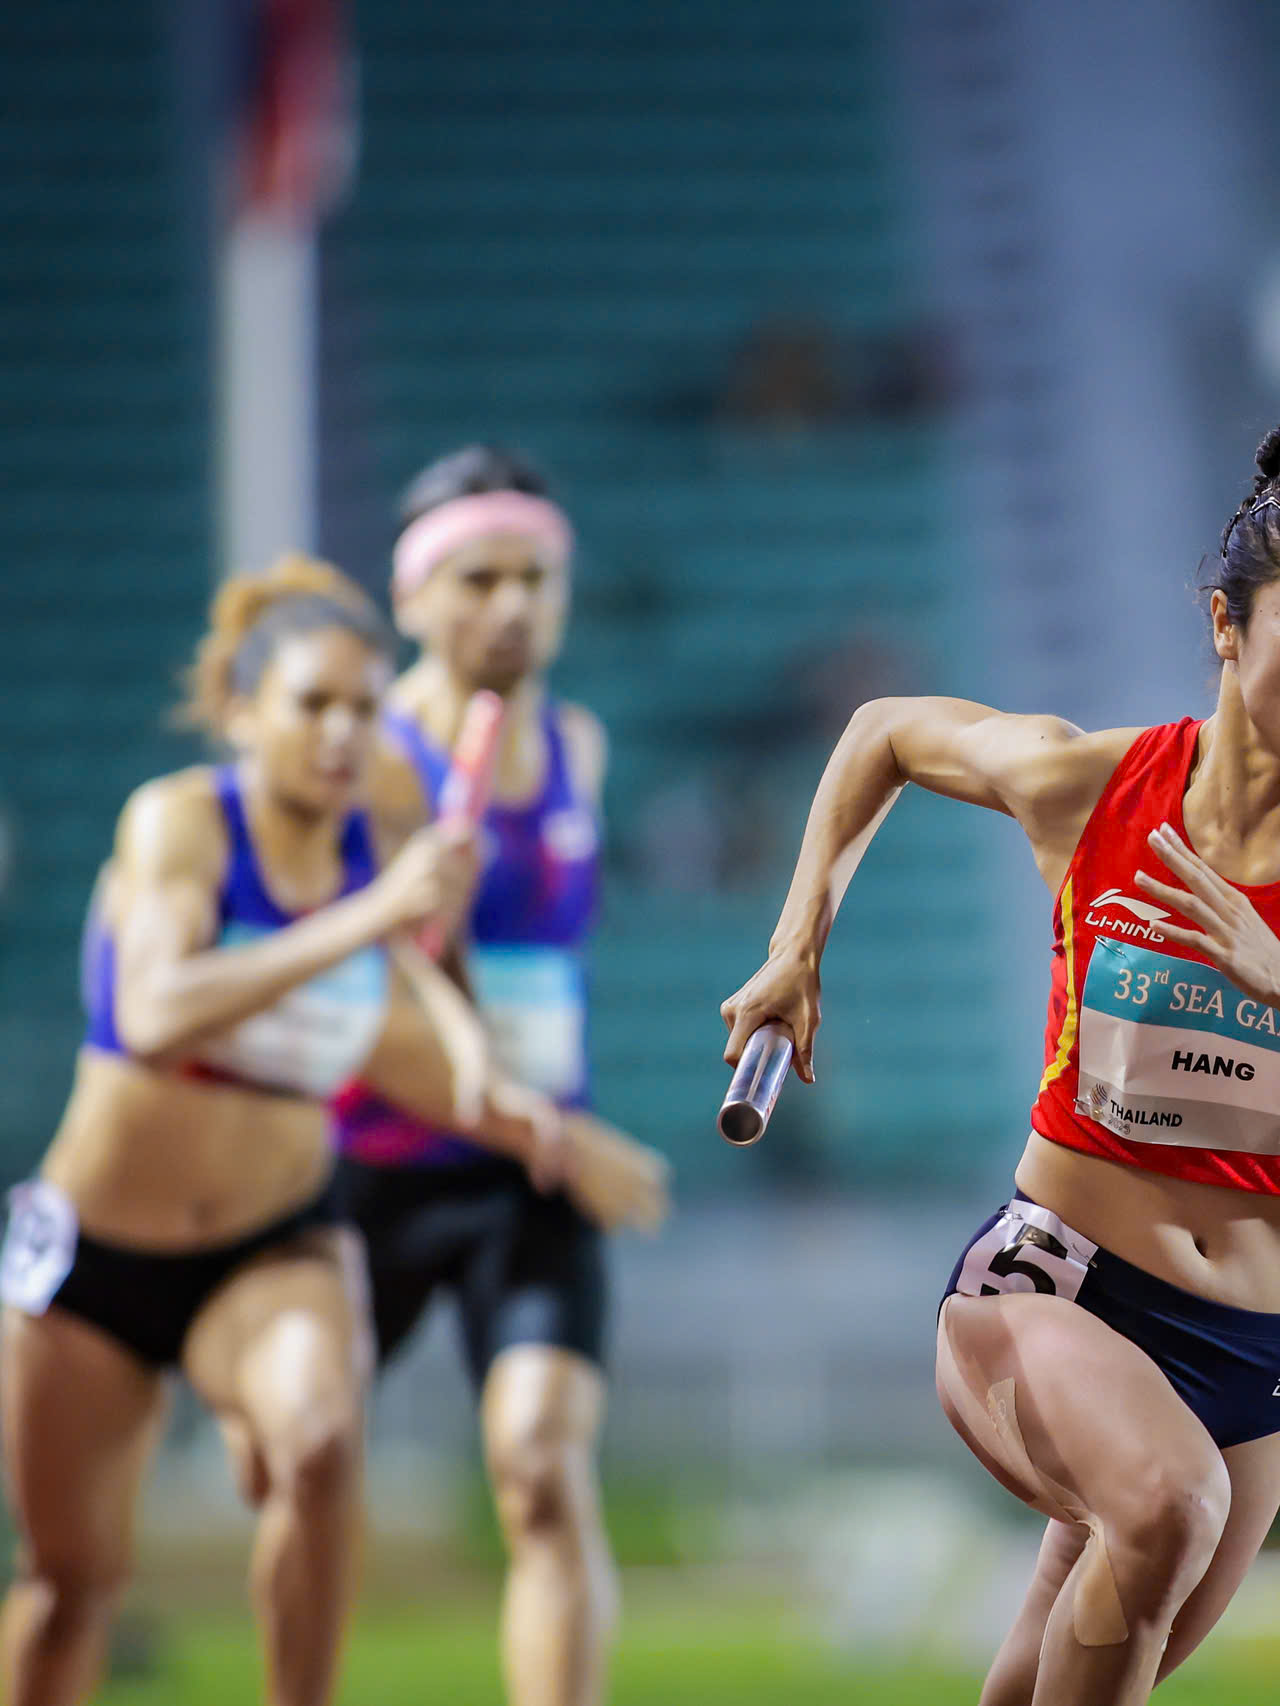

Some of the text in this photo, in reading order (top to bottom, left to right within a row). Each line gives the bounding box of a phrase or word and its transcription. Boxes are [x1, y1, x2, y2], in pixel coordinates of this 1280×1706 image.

[1113, 968, 1170, 1005] 33rd
[1169, 982, 1225, 1019] SEA
[1171, 1050, 1256, 1082] HANG
[1110, 1099, 1183, 1127] THAILAND
[979, 1222, 1069, 1297] 5
